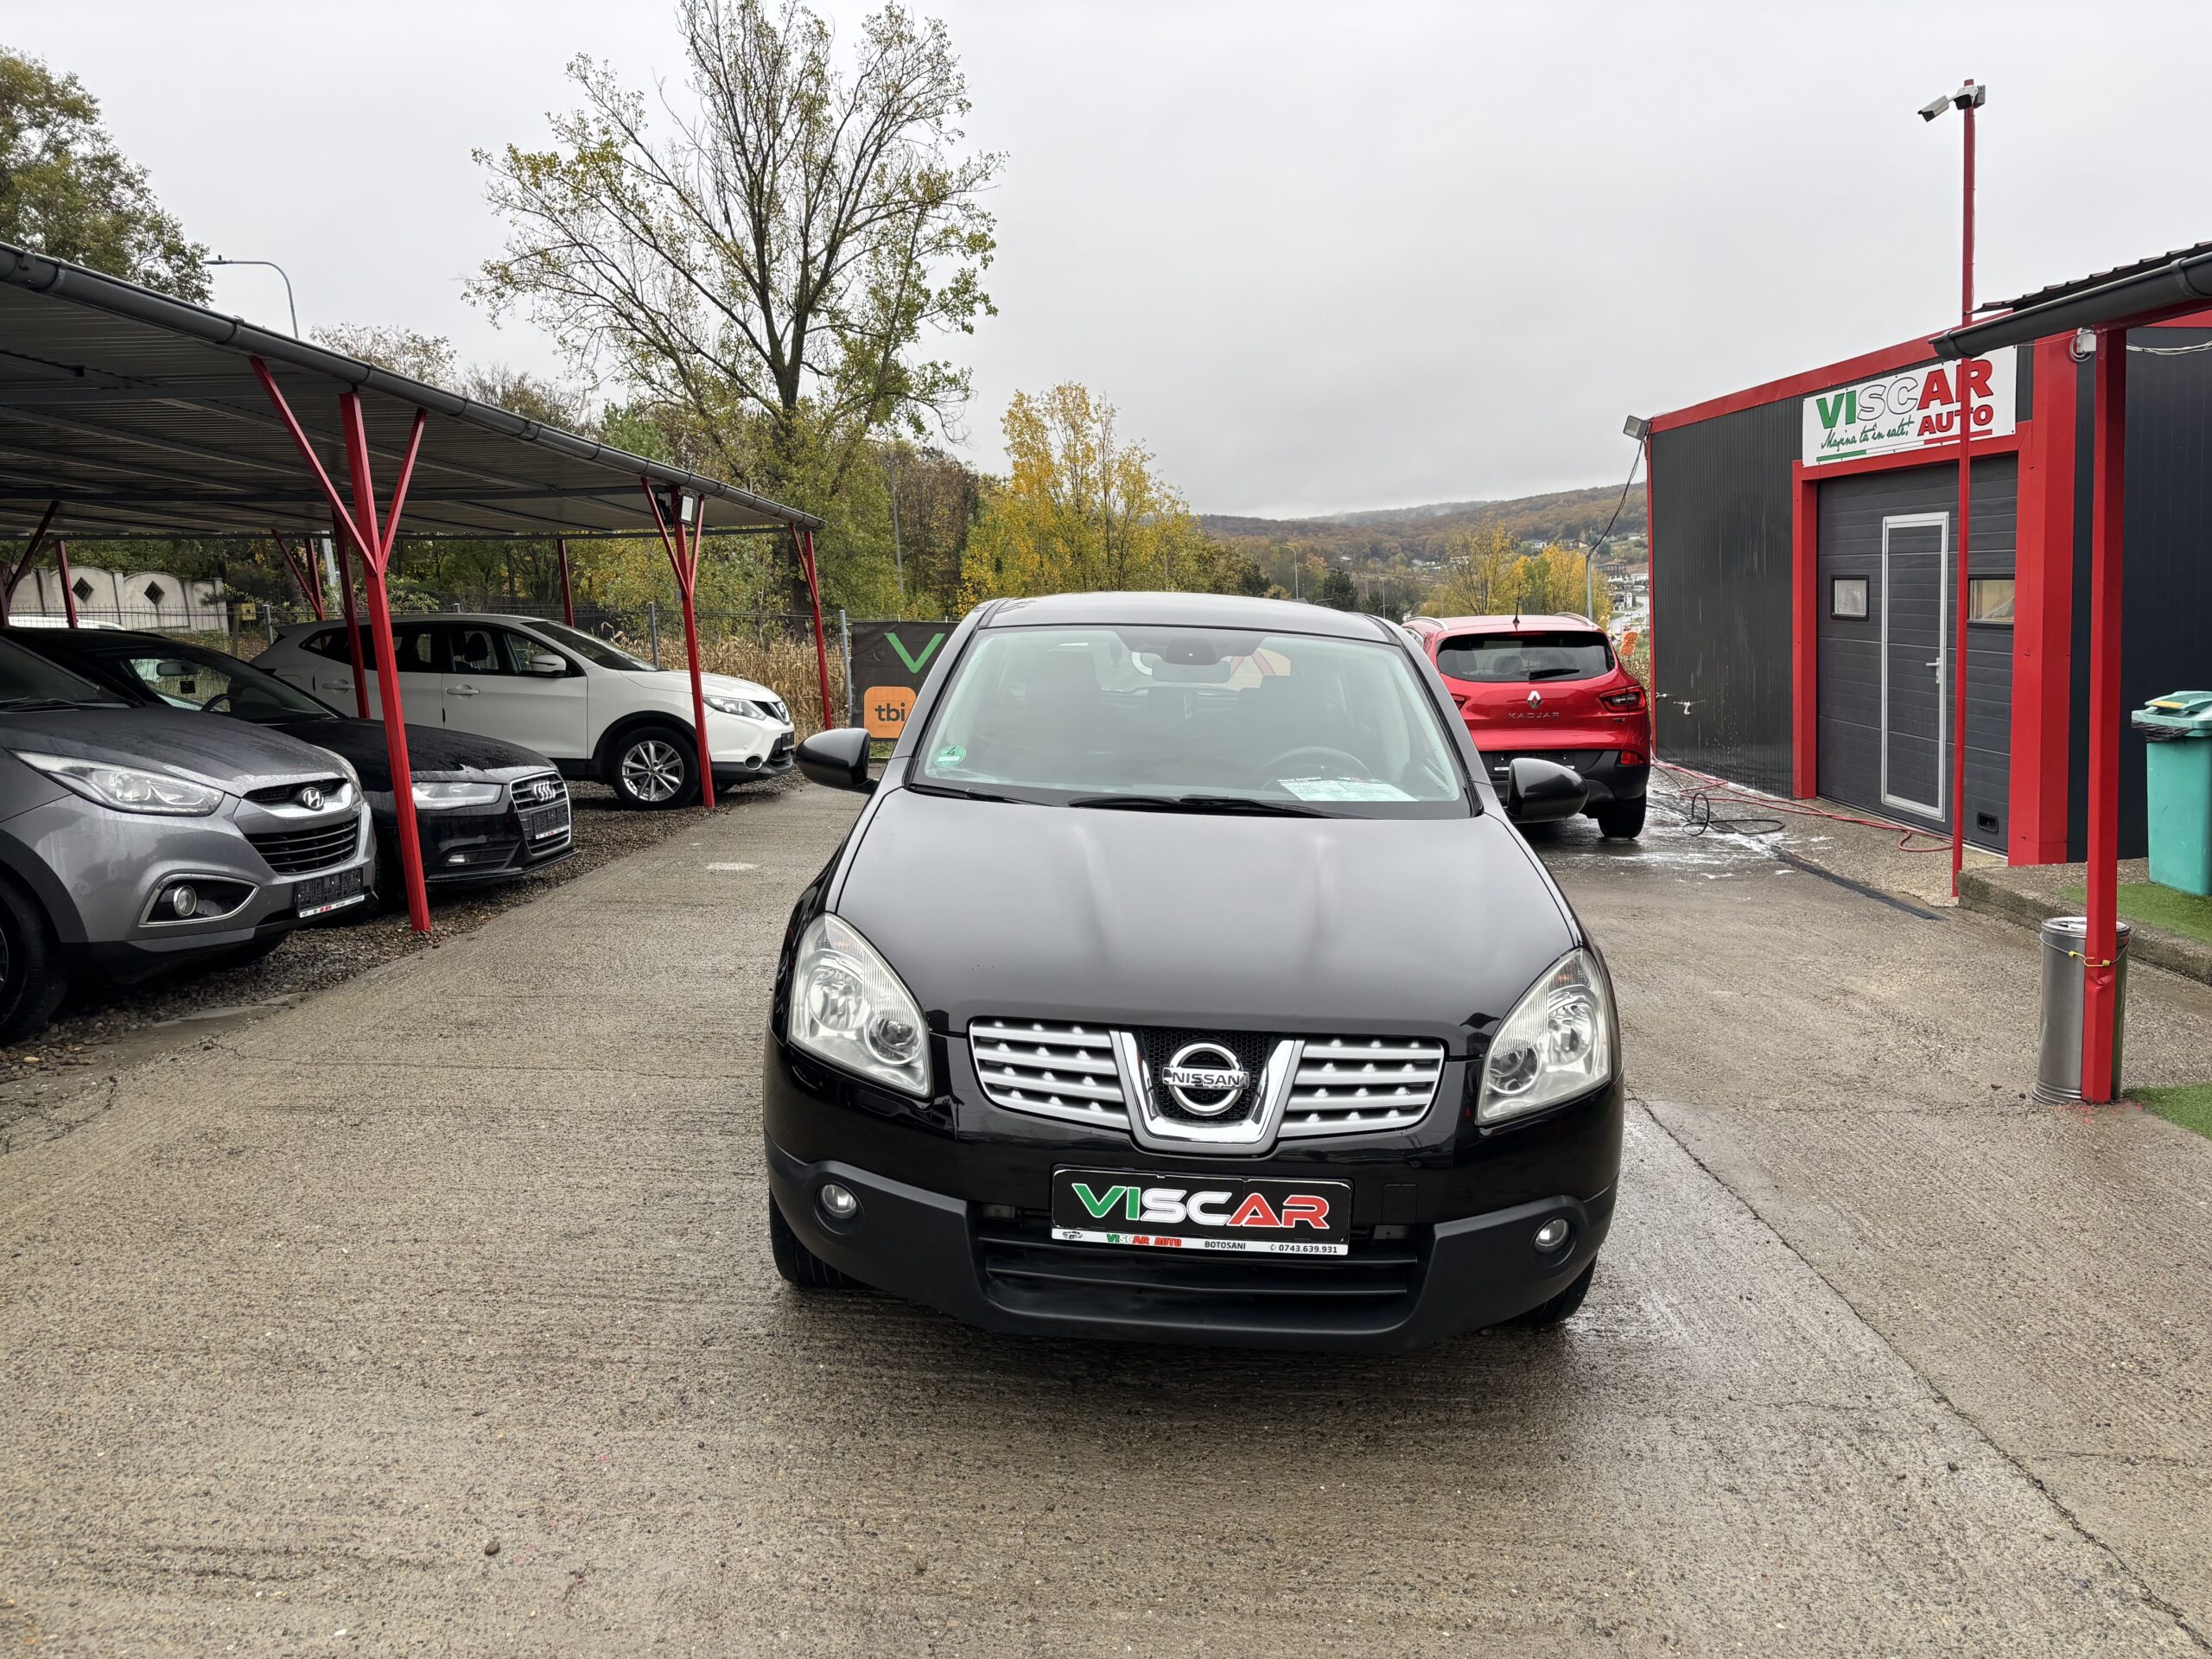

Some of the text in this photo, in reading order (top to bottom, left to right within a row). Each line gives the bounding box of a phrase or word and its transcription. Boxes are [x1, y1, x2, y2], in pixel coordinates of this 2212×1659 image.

[1816, 359, 1993, 429] VISCAR
[874, 702, 906, 722] tbi
[1172, 1071, 1240, 1085] NISSAN
[1071, 1183, 1331, 1230] VISCAR
[1106, 1233, 1338, 1254] VISCAR AUTO BOTOSANI 0743.639.931
